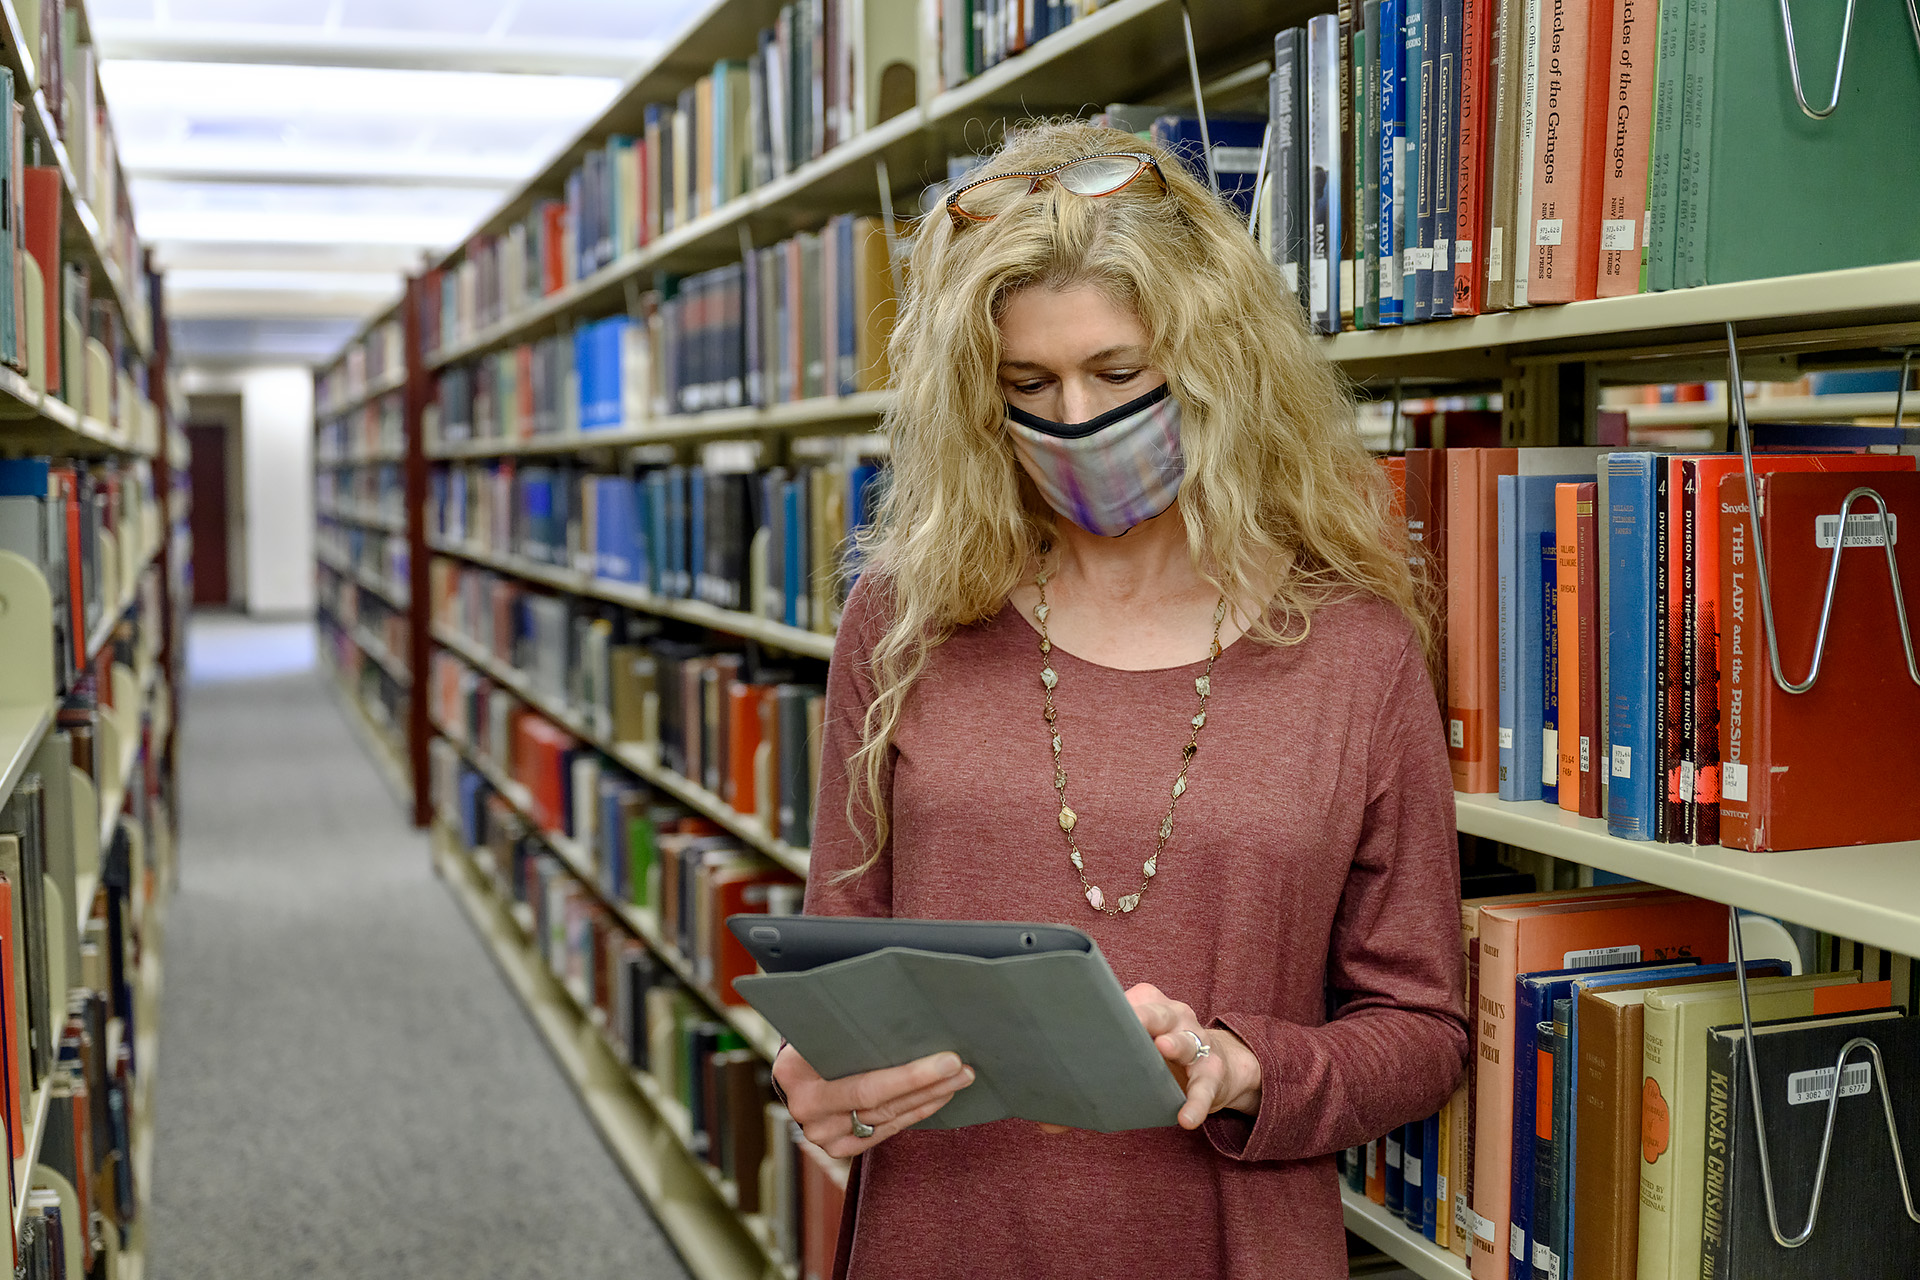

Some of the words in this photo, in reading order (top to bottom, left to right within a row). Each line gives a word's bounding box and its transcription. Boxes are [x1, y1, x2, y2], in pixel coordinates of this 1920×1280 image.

[1622, 0, 1635, 45] icles
[1340, 34, 1349, 57] THE
[1463, 0, 1474, 118] BEAUREGARD
[1619, 50, 1633, 68] of
[1549, 58, 1562, 76] of
[1340, 60, 1349, 107] MEXICAN
[1382, 67, 1394, 110] Mr.
[1525, 73, 1535, 107] Killing
[1549, 80, 1562, 109] the
[1619, 73, 1632, 101] the
[1340, 108, 1349, 133] WAR
[1525, 110, 1534, 139] Affair
[1461, 128, 1471, 145] IN
[1544, 112, 1560, 184] Gringos
[1613, 105, 1630, 179] Gringos
[1382, 118, 1394, 186] Polk's
[1439, 137, 1447, 200] Portsmouth
[1681, 147, 1691, 193] 973.63
[1458, 155, 1470, 227] MEXICO
[1379, 192, 1393, 255] Army
[1658, 479, 1667, 496] 4
[1684, 478, 1693, 495] 4
[1720, 502, 1750, 515] Snyde
[1560, 545, 1576, 554] MILLARD
[1658, 511, 1666, 562] DIVISION
[1732, 522, 1745, 566] THE
[1825, 537, 1829, 546] 3
[1559, 558, 1578, 567] FILLMORE
[1658, 566, 1666, 590] AND
[1658, 594, 1666, 615] THE
[1732, 572, 1744, 623] LADY
[1731, 624, 1743, 657] and
[1658, 670, 1665, 685] OF
[1684, 669, 1691, 685] OF
[1731, 657, 1743, 684] the
[1730, 688, 1743, 764] PRESID
[1479, 994, 1506, 1020] LINCOLN'S
[1482, 1019, 1497, 1040] LOST
[1480, 1041, 1500, 1065] SPEECH
[1797, 1093, 1802, 1102] 3
[1805, 1090, 1822, 1100] 3082
[1849, 1084, 1865, 1093] 6777
[1708, 1070, 1728, 1154] KANSAS
[1553, 1116, 1561, 1163] Franklin
[1551, 1168, 1560, 1202] Pierce
